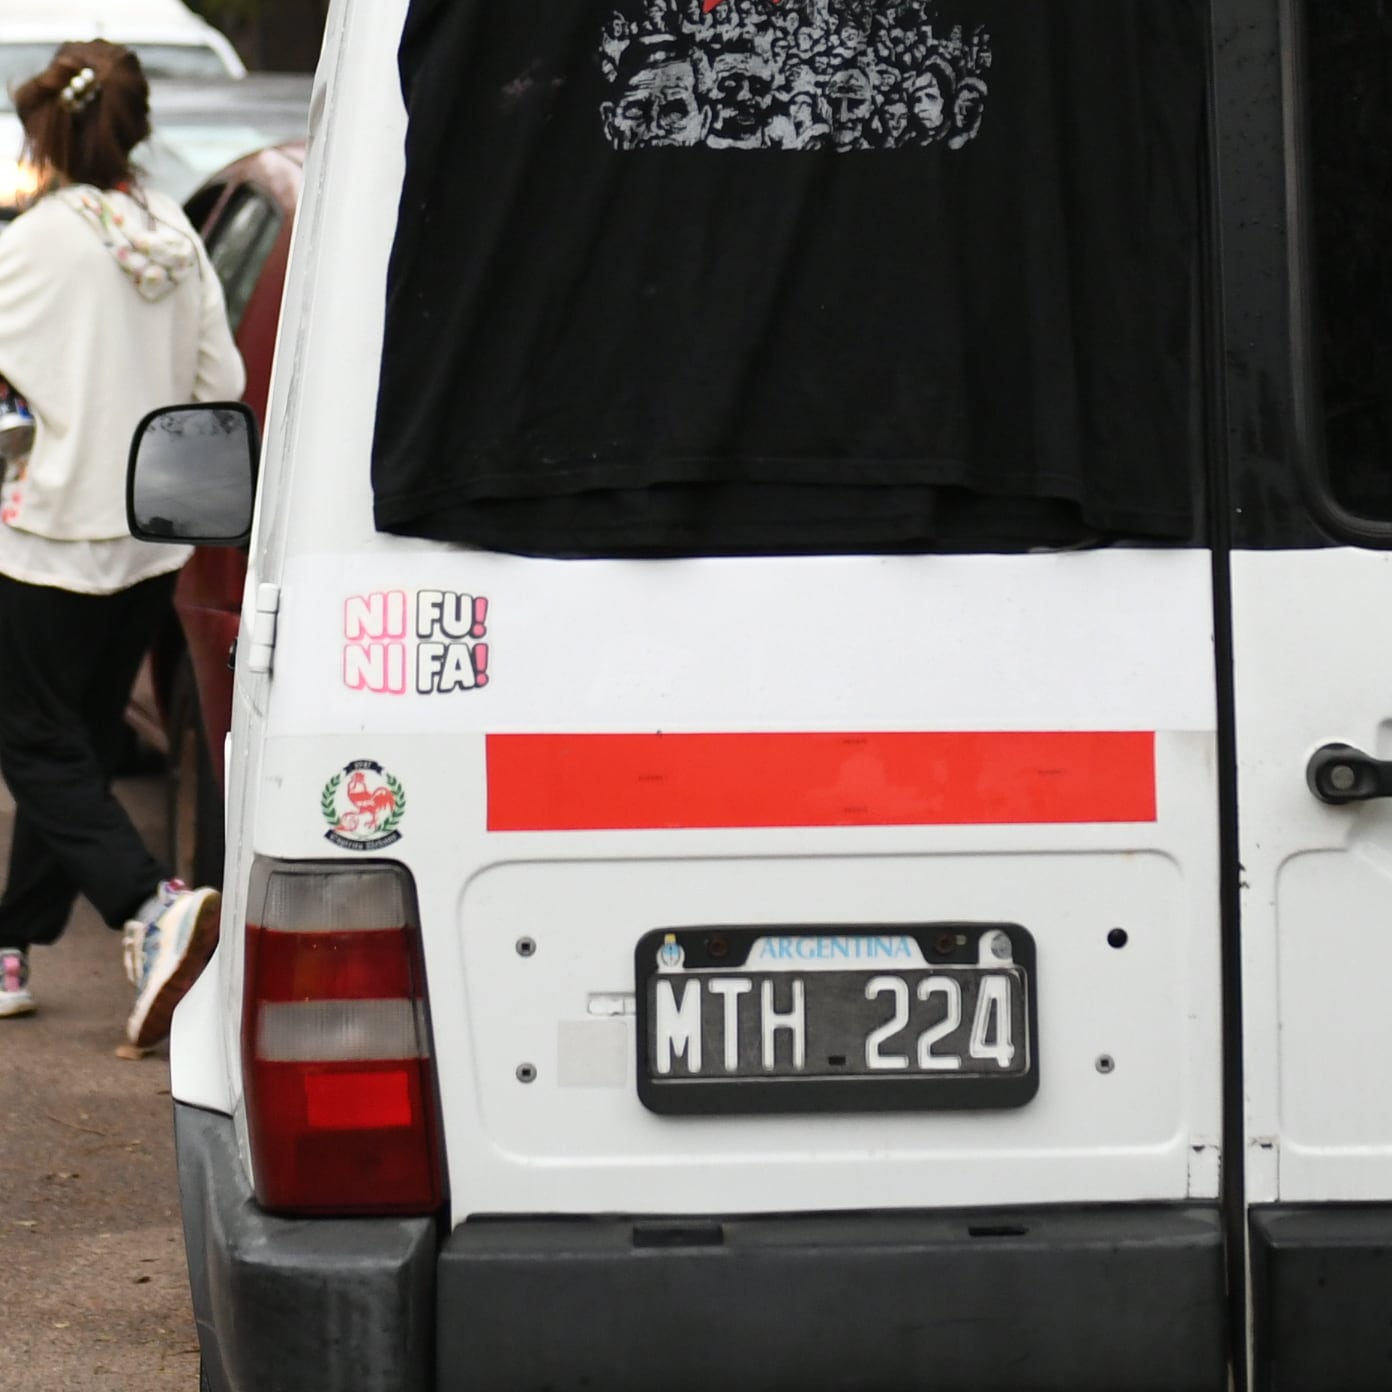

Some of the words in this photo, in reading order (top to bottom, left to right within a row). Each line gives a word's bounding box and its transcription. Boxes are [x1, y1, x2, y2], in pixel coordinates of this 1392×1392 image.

[345, 590, 407, 640] NI
[416, 589, 488, 639] FU!
[344, 642, 406, 695] NI
[416, 641, 489, 695] FA!
[759, 935, 913, 961] ARGENTINA
[655, 977, 806, 1074] MTH
[864, 975, 1015, 1070] 224
